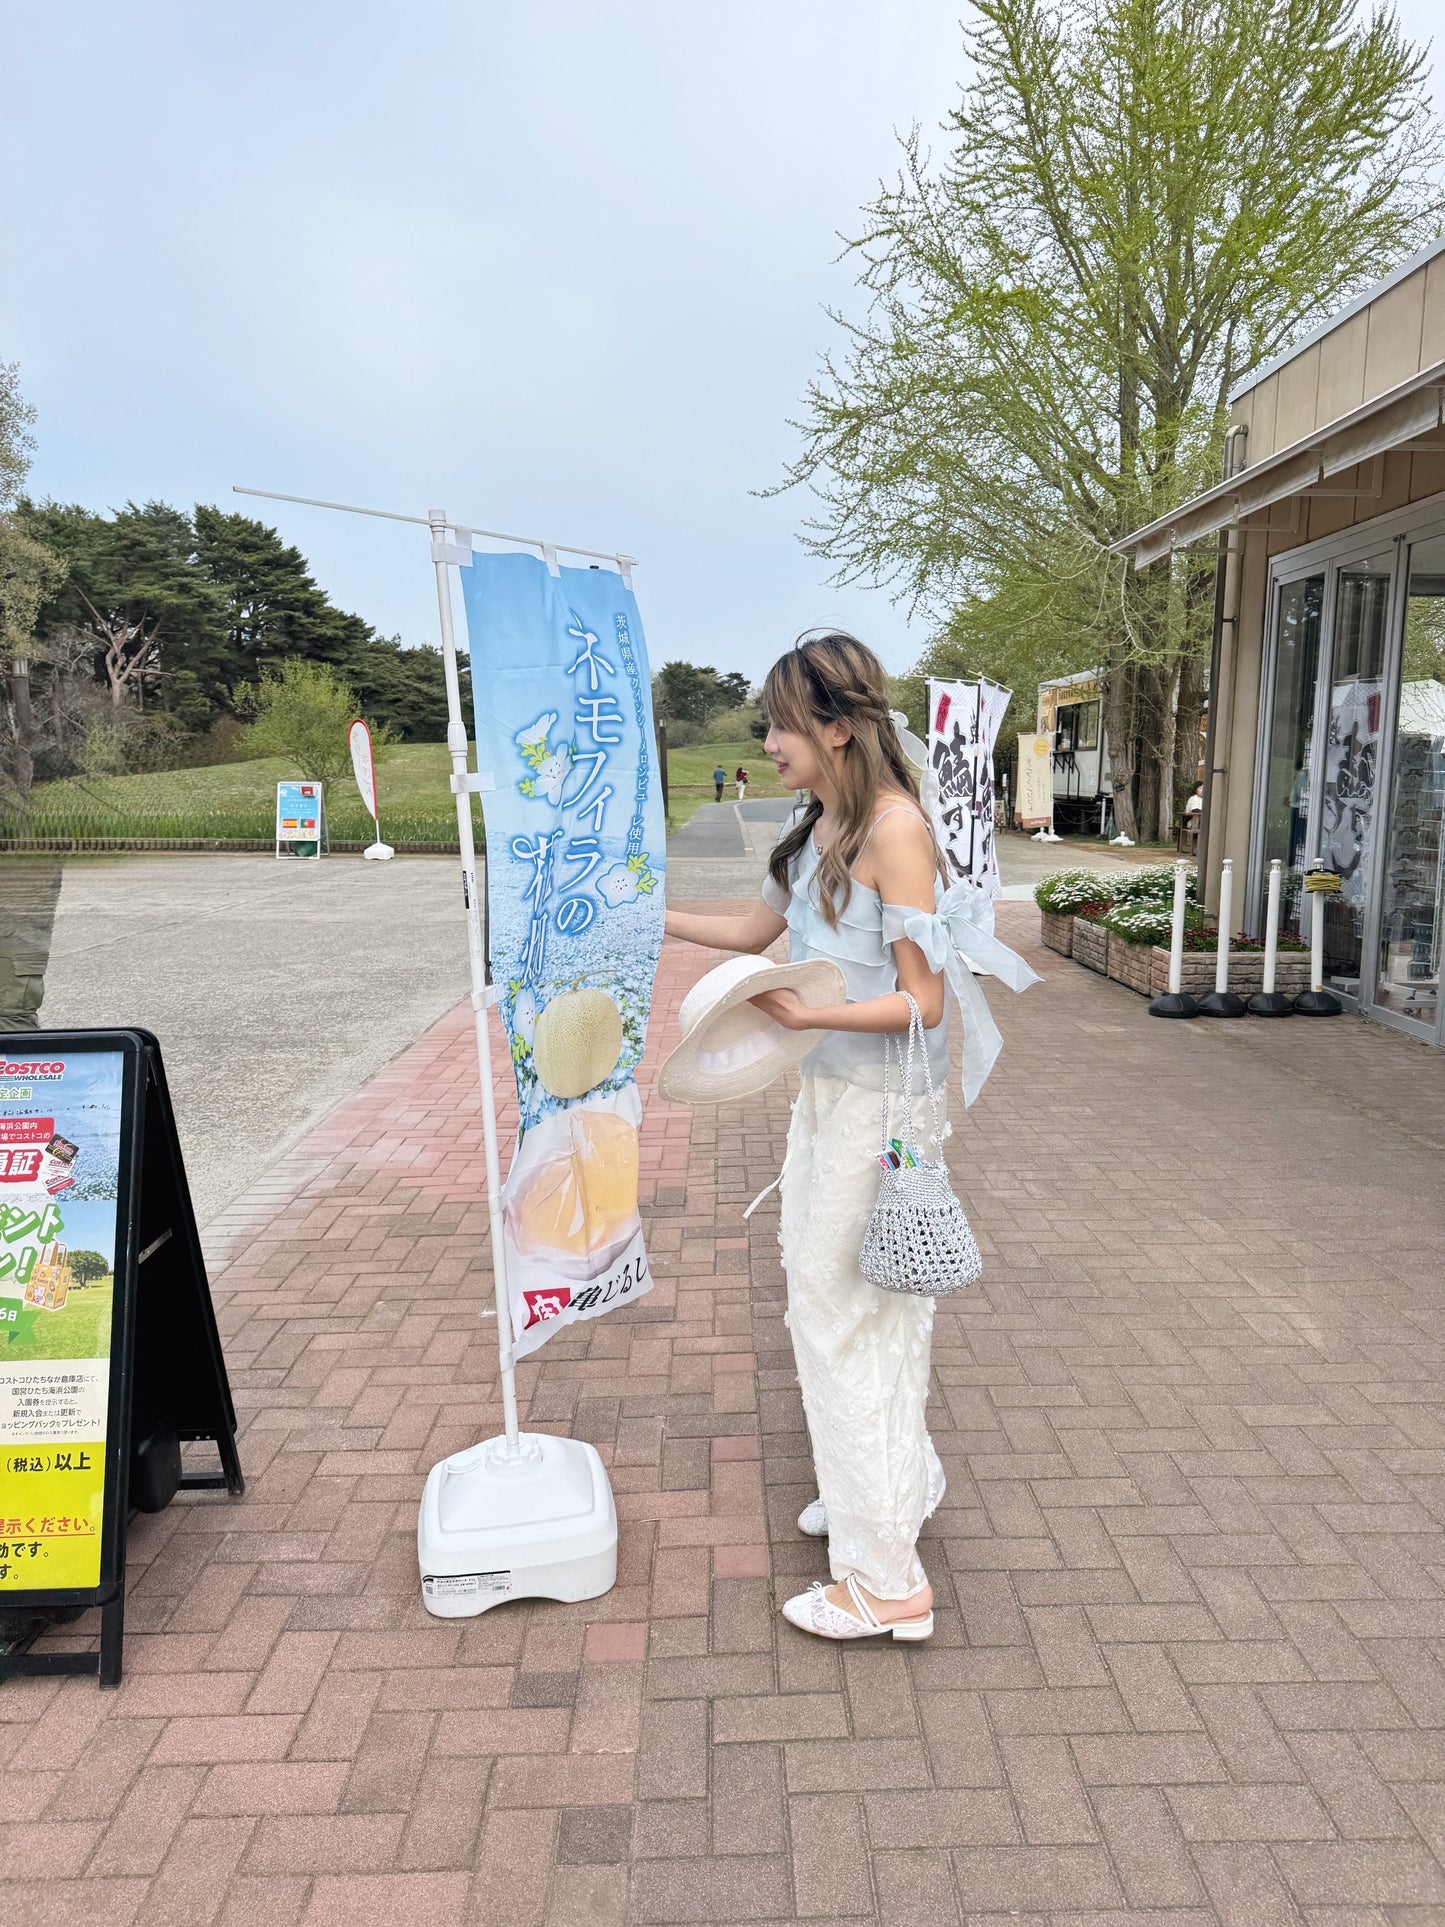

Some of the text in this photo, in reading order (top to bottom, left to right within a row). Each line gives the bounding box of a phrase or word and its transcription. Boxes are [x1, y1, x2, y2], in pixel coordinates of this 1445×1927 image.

[615, 613, 649, 856] 茨城県産クインシーメロンピューレ使用
[556, 606, 623, 934] ネモフィラの
[0, 1088, 31, 1099] 定企画
[1, 1132, 51, 1141] 場でコストコの
[0, 1203, 62, 1241] ント
[568, 1256, 648, 1311] 亀じるし
[12, 1386, 85, 1396] 国営ひたち海浜公園の
[12, 1408, 82, 1418] 新規入会または更新で
[7, 1452, 91, 1472] （税込）以上
